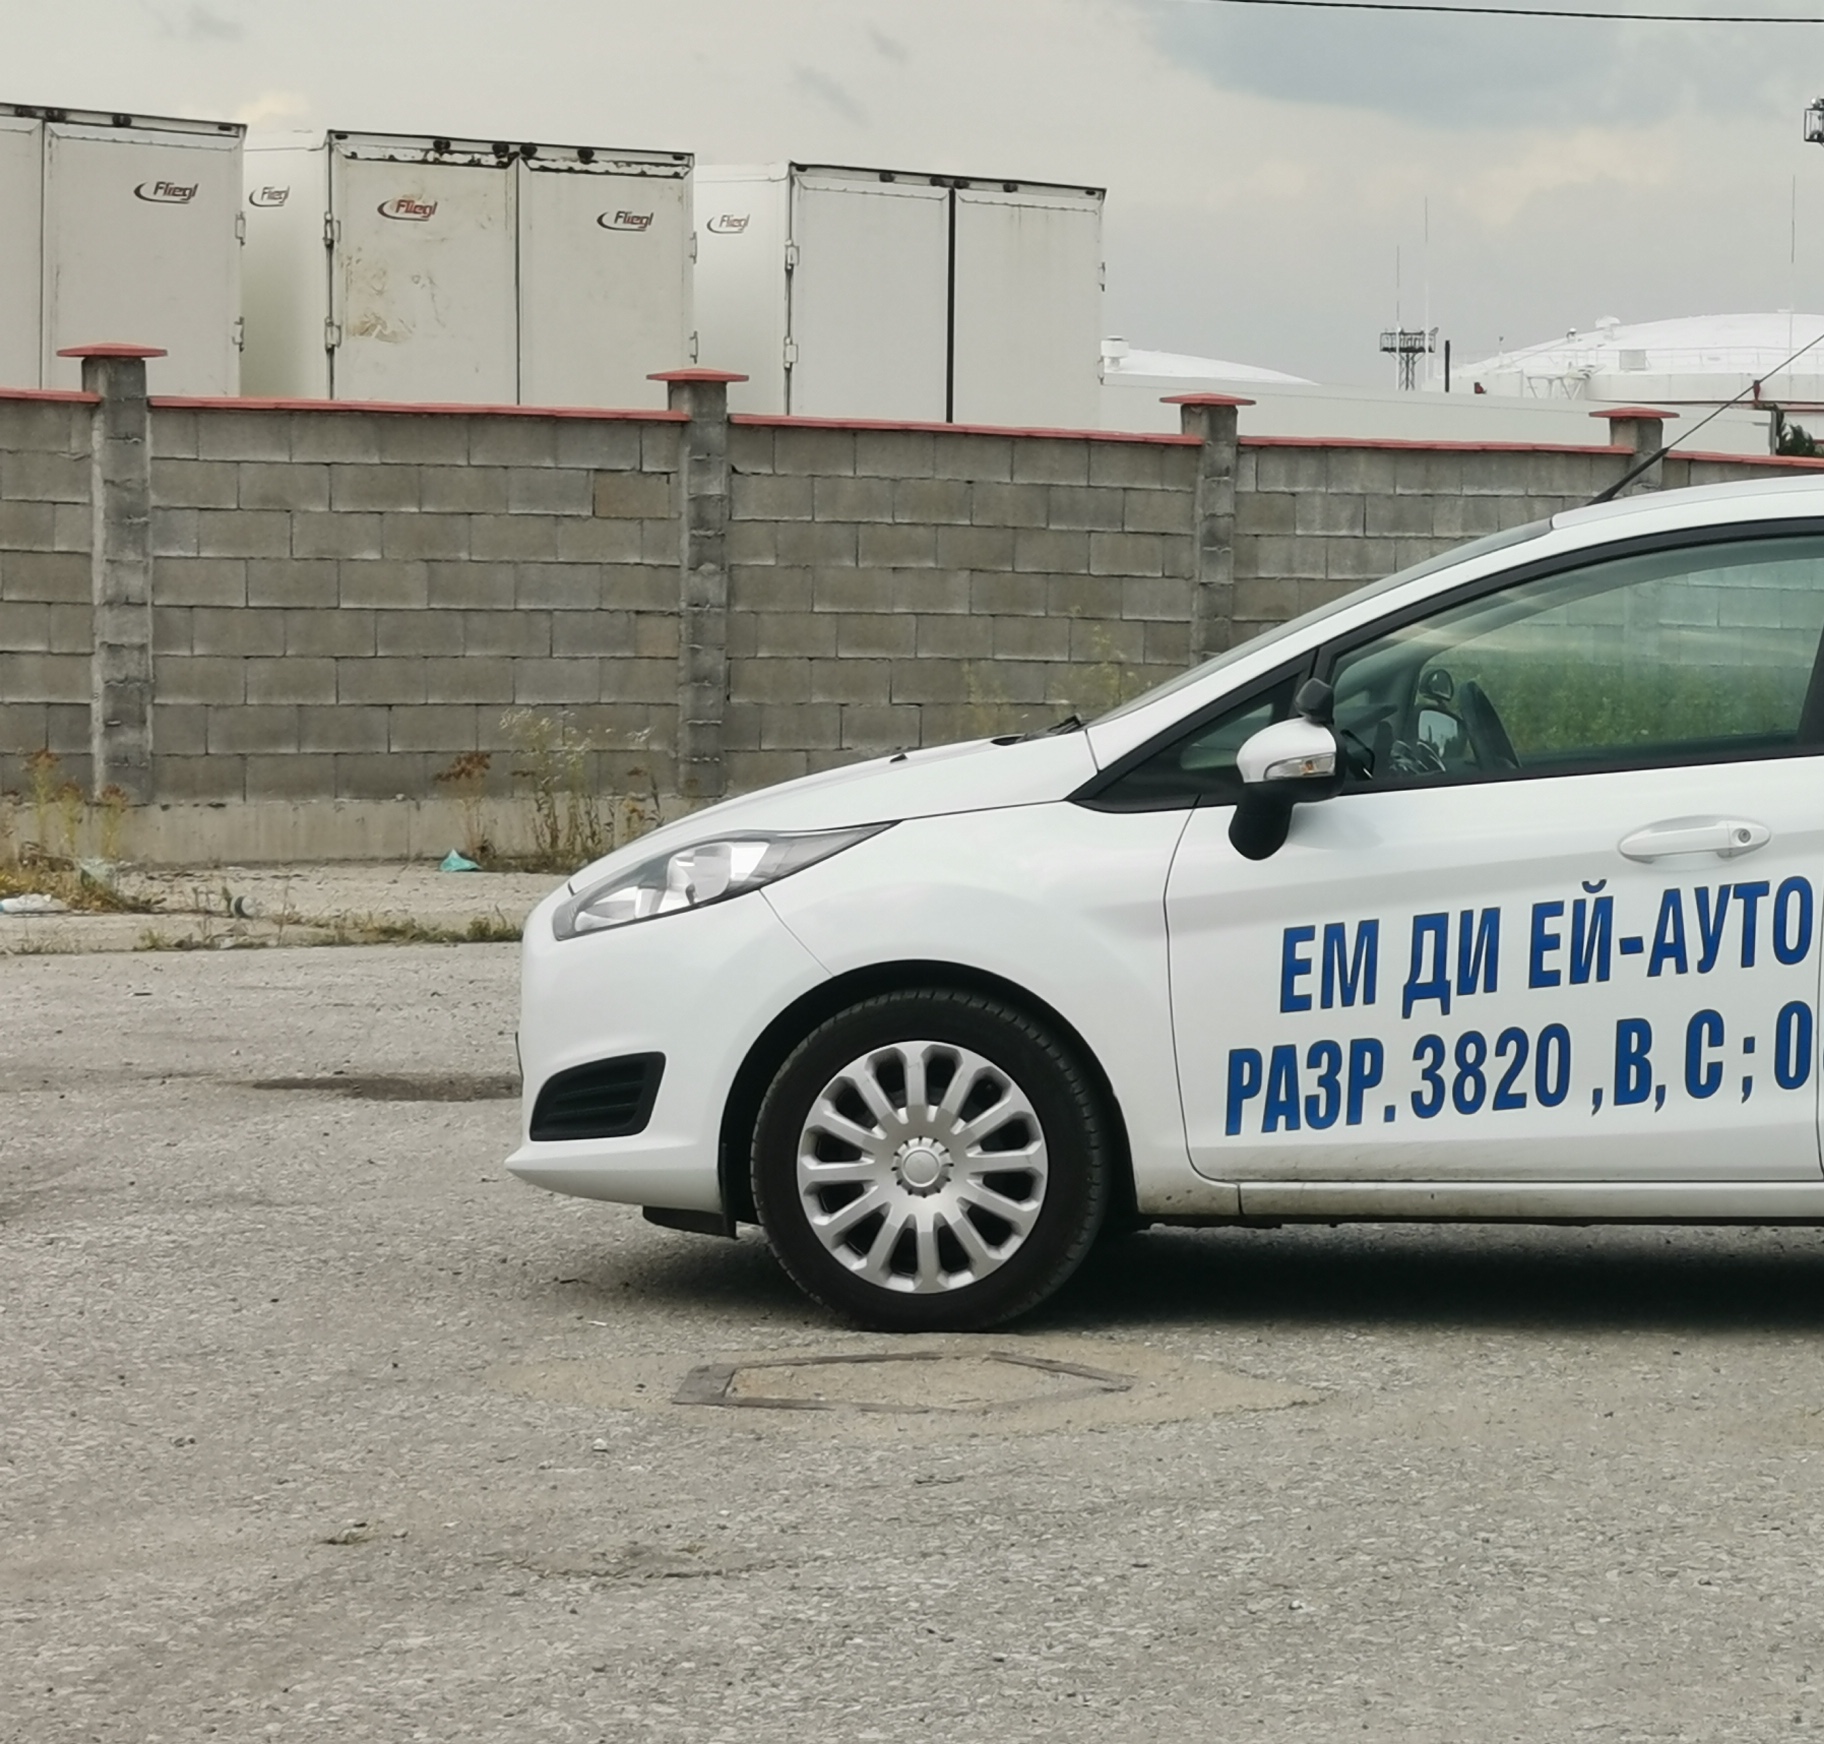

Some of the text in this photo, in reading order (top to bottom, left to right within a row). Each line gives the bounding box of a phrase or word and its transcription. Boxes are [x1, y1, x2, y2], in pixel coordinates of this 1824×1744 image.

[395, 199, 438, 218] Fliegl
[614, 210, 654, 229] Fliegl
[1280, 919, 1380, 1013] ЕМ
[1402, 907, 1500, 1019] ДИ
[1529, 876, 1813, 989] ЕЙ-АУТО
[1225, 1038, 1396, 1136] РАЗР.
[1411, 1023, 1571, 1118] 3820
